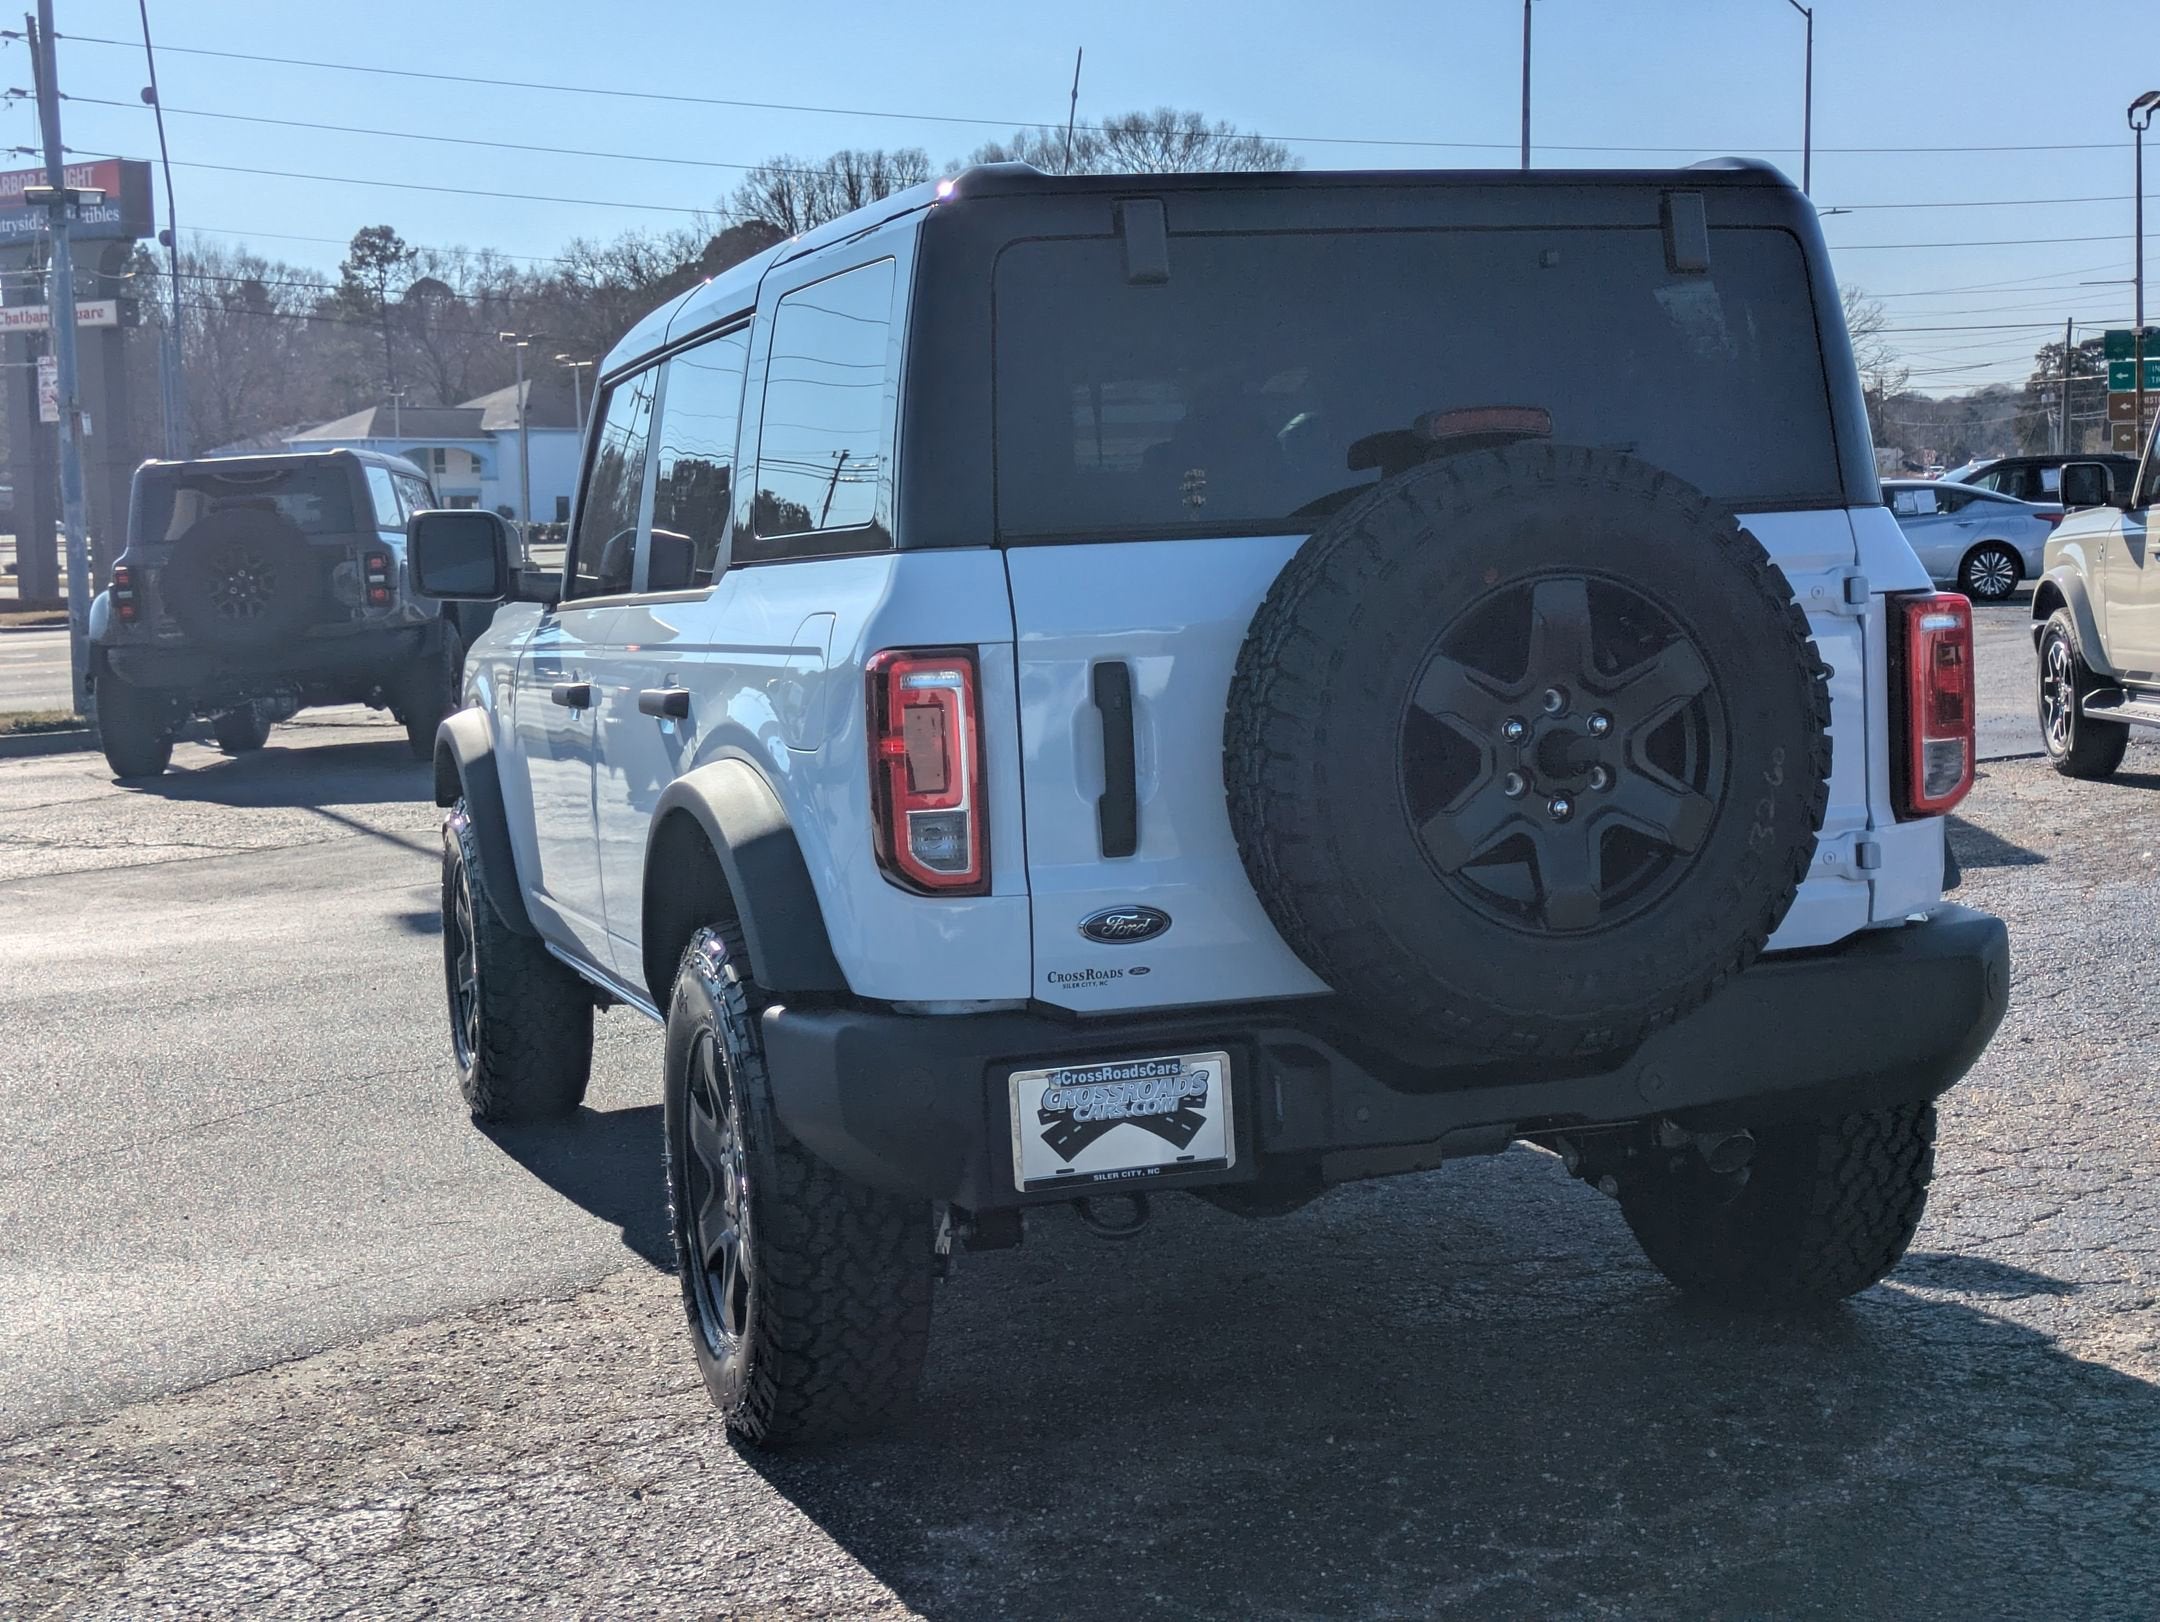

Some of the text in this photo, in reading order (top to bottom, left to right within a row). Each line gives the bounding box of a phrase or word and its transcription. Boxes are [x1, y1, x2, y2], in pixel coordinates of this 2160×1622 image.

[40, 167, 95, 188] FIGHT
[1101, 914, 1152, 935] Ford
[1061, 1063, 1179, 1085] CrossRoadsCars
[1042, 1070, 1209, 1111] CROSSROADS
[1073, 1097, 1180, 1122] CARS.COM
[1093, 1172, 1119, 1181] SILER
[1121, 1169, 1145, 1178] CITY,
